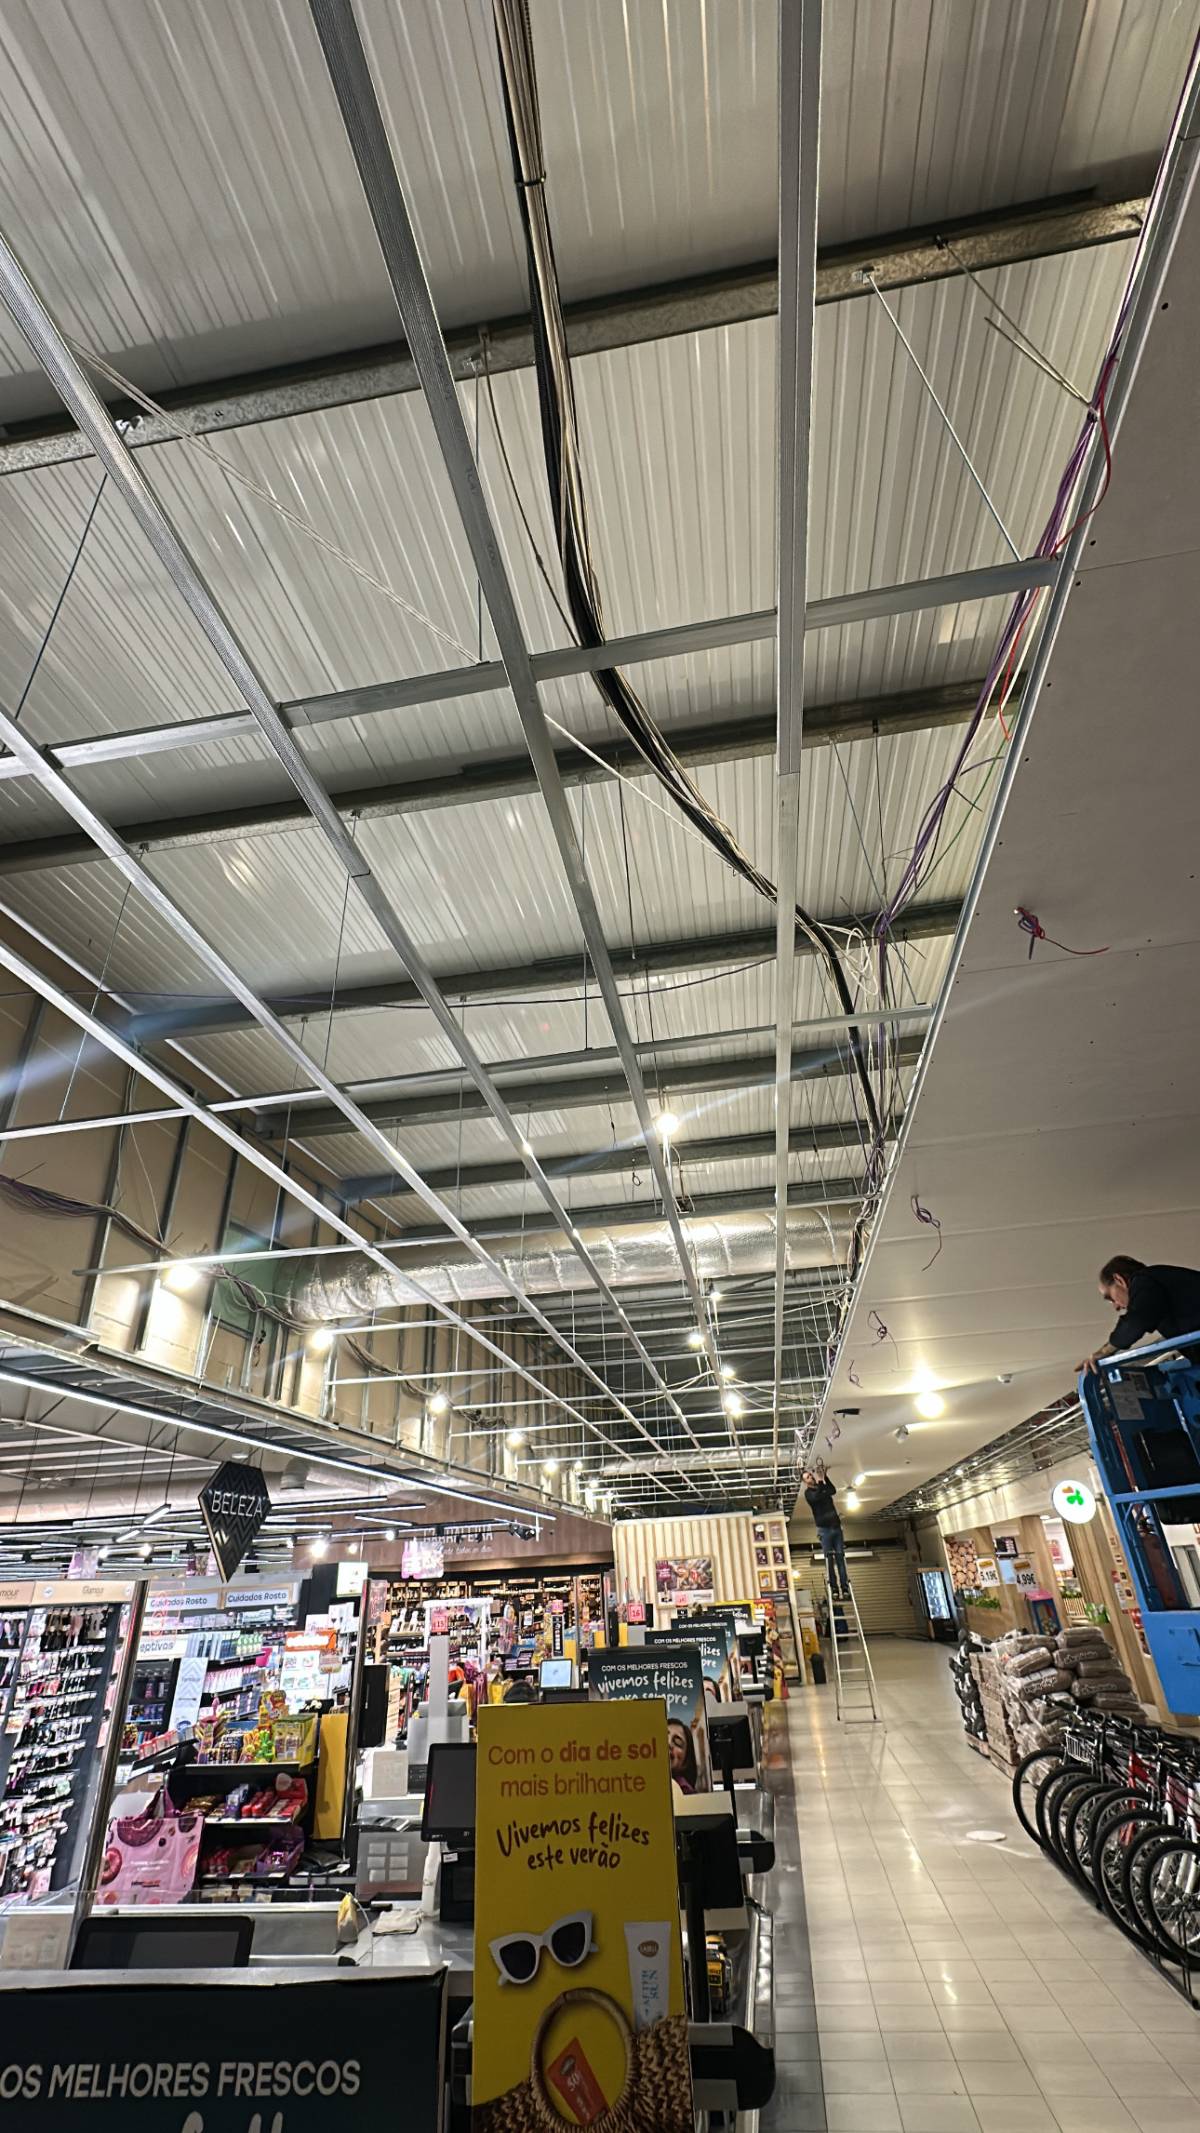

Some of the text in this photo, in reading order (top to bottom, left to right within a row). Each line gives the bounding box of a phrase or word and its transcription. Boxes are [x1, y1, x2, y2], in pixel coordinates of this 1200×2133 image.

[211, 1490, 263, 1518] BELEZA
[150, 1596, 208, 1607] Cuidados Rosto
[227, 1591, 287, 1602] Cuidados Rosto
[698, 1643, 721, 1657] lizes
[601, 1664, 616, 1672] COM
[626, 1663, 659, 1671] MELHORES
[659, 1662, 688, 1670] FRESCOS
[598, 1671, 694, 1694] vivemos felizes
[488, 1737, 657, 1765] Com o dia de sol
[501, 1772, 646, 1797] mais brilhante
[496, 1811, 650, 1857] Vivemos felizes
[527, 1842, 621, 1871] este verão
[0, 2059, 361, 2099] OS MELHORES FRESCOS
